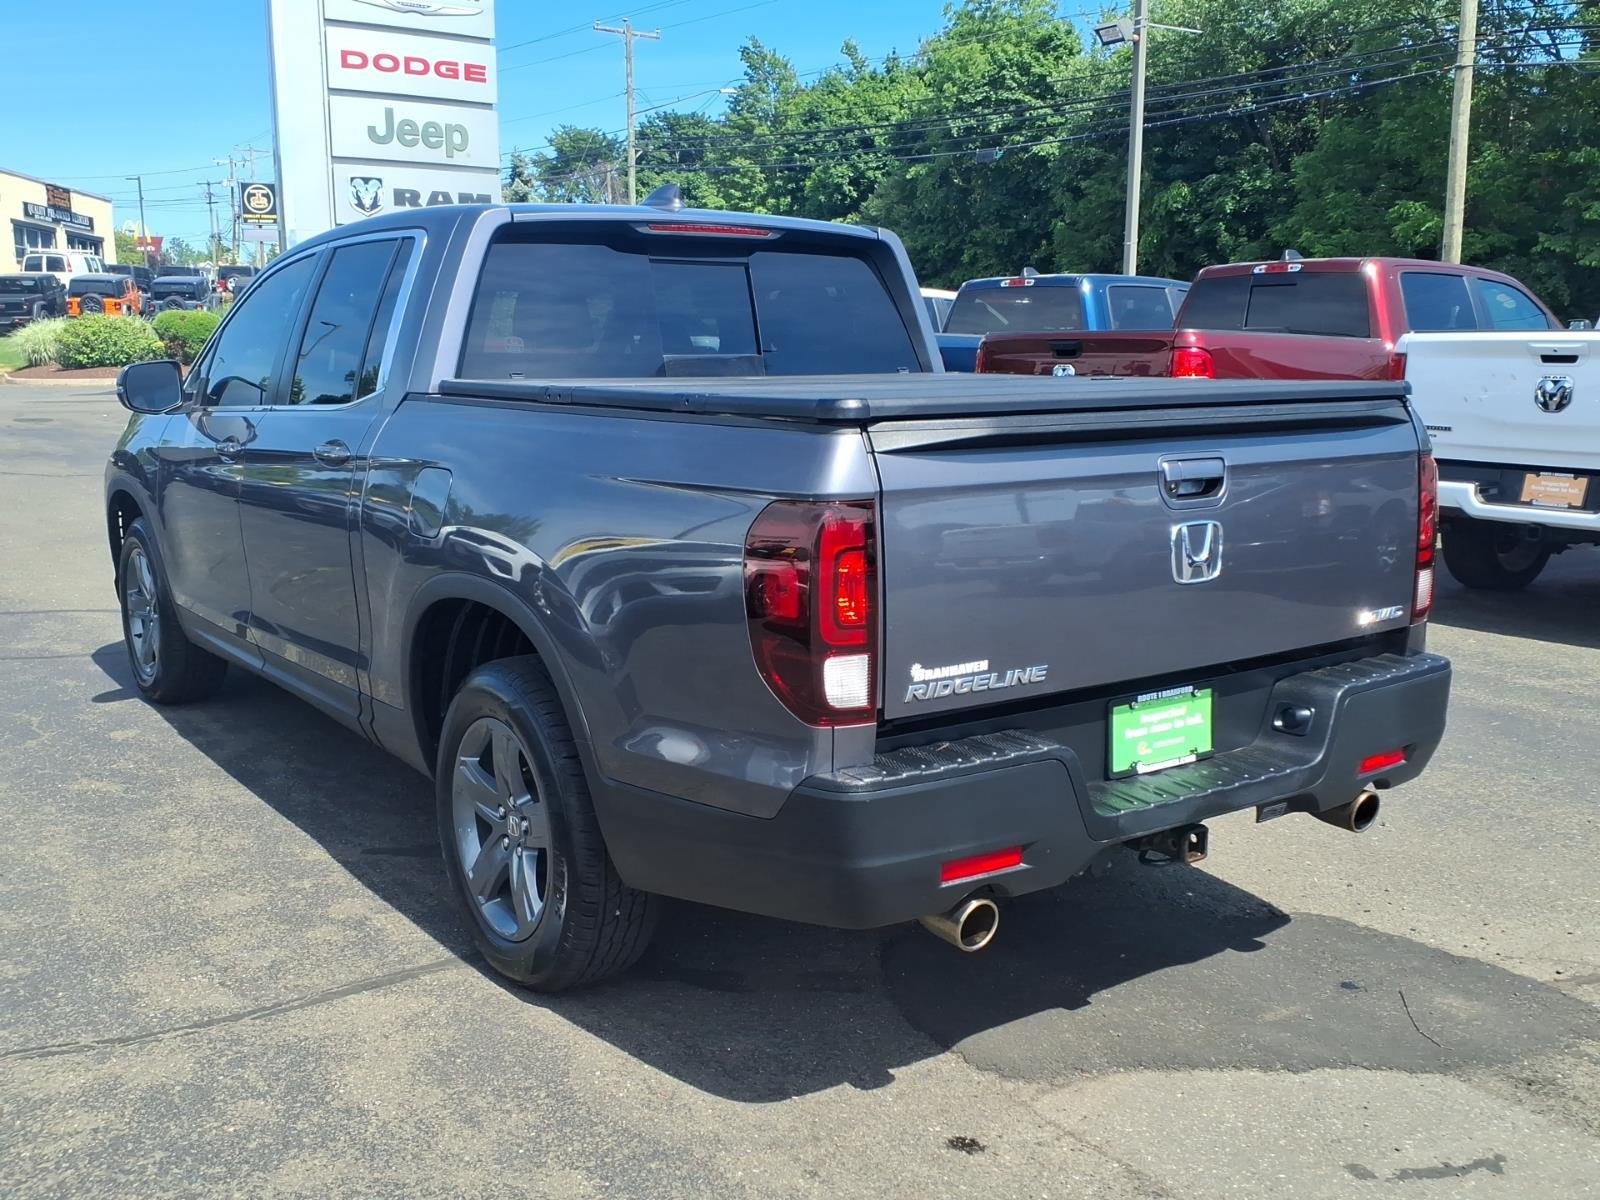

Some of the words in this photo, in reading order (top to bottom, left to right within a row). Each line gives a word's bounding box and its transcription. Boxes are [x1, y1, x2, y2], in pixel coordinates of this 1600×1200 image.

[340, 49, 487, 84] DODGE
[367, 106, 470, 159] Jeep
[393, 187, 492, 207] RAM
[904, 664, 1049, 704] RIDGELINE
